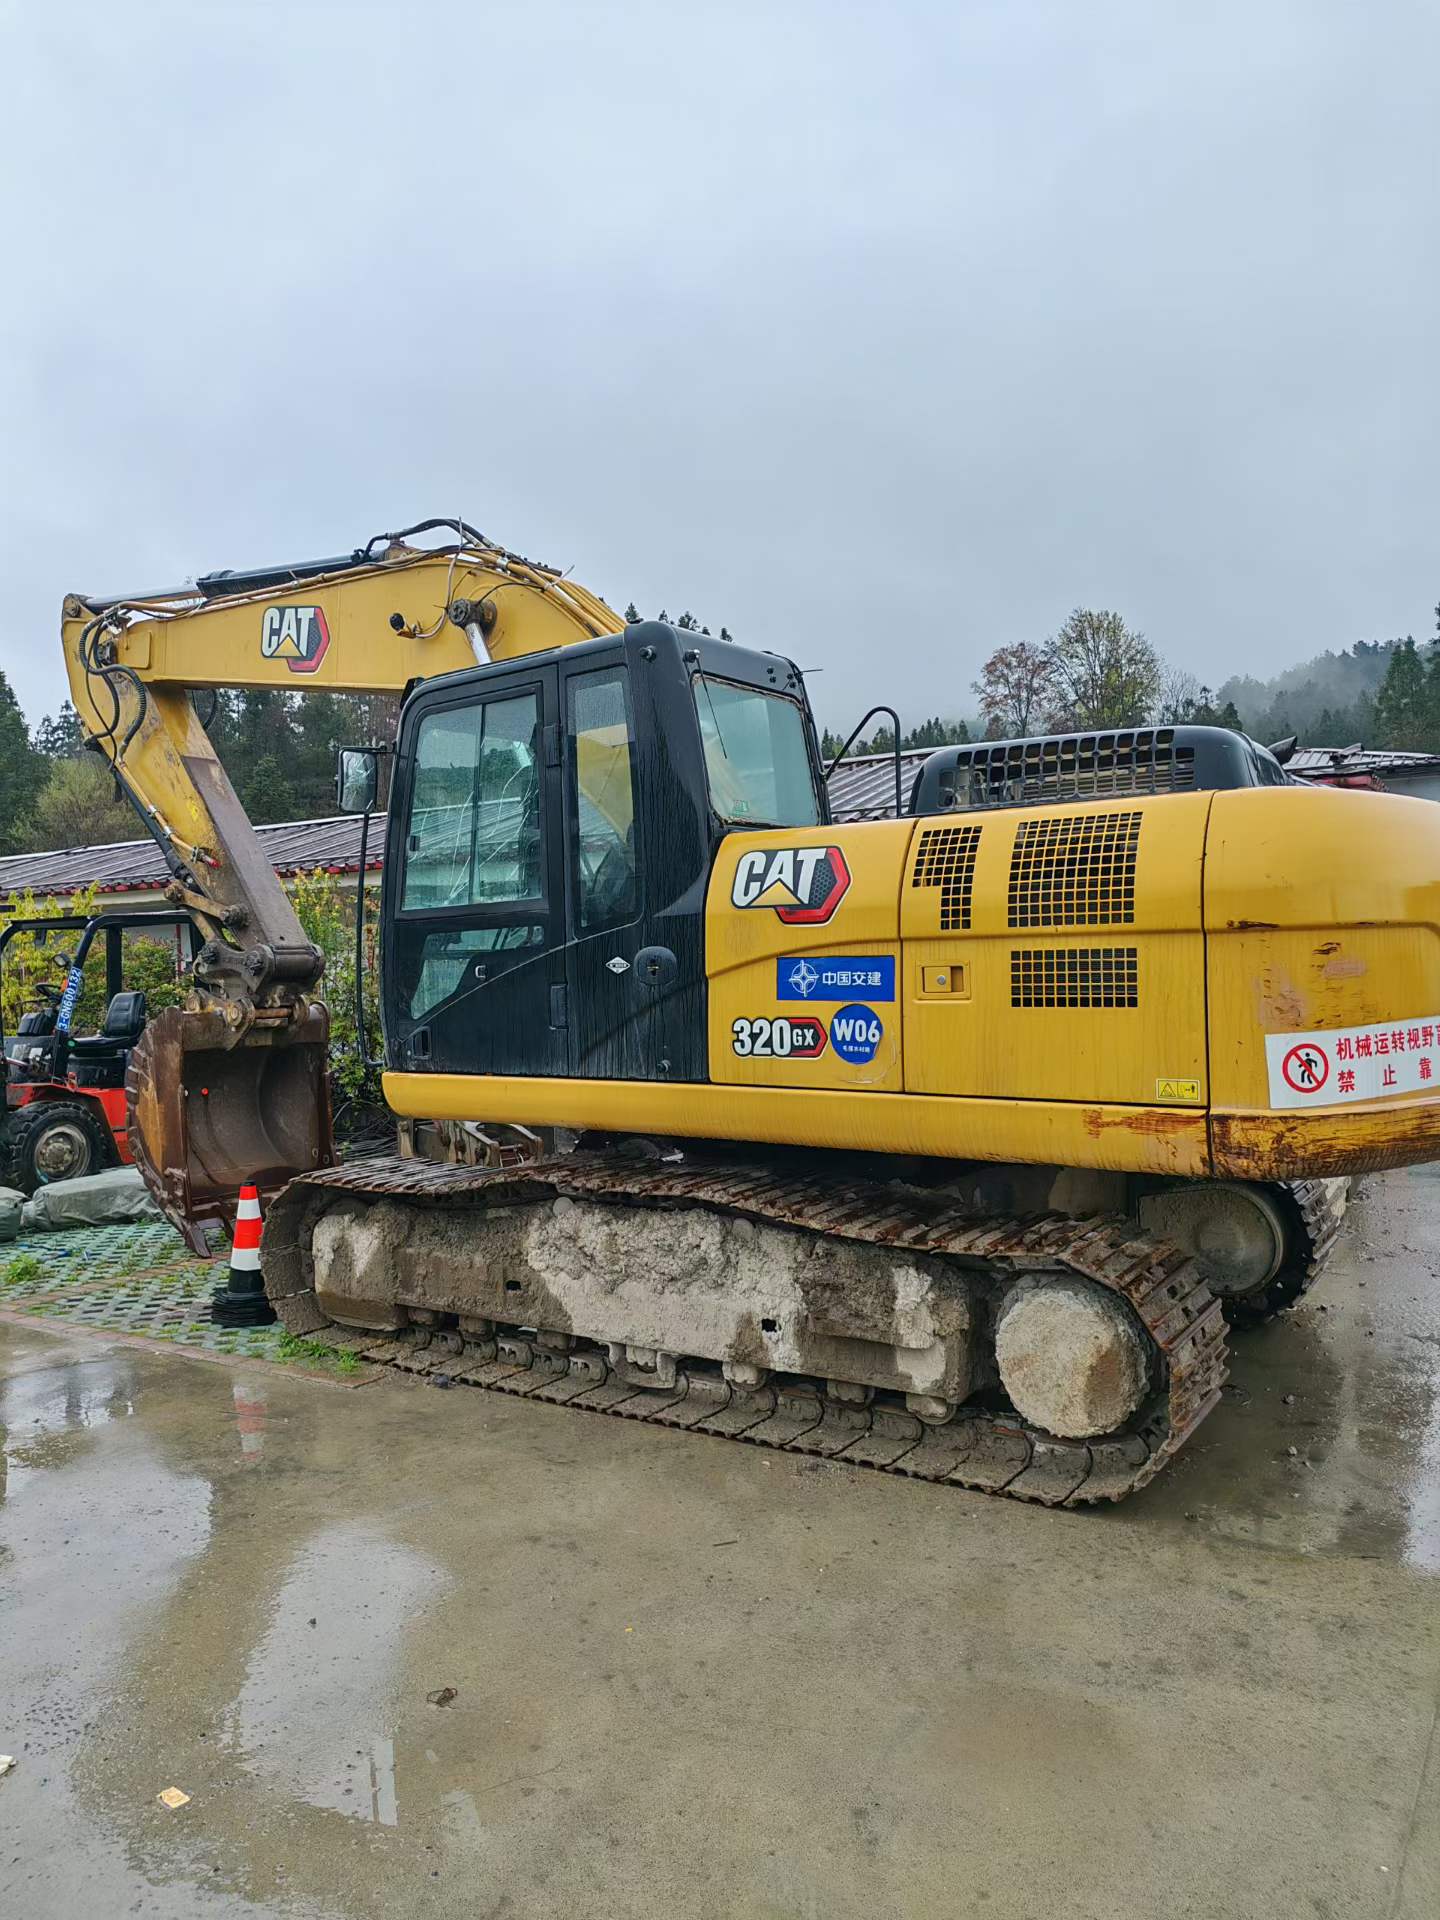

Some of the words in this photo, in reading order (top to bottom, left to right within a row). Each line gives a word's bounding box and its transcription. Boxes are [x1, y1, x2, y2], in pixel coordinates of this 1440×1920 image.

[262, 607, 315, 657] CAT
[732, 847, 827, 907] CAT
[58, 969, 81, 1030] 3-GN600132
[822, 971, 882, 986] 中国交建
[833, 1018, 880, 1043] W06
